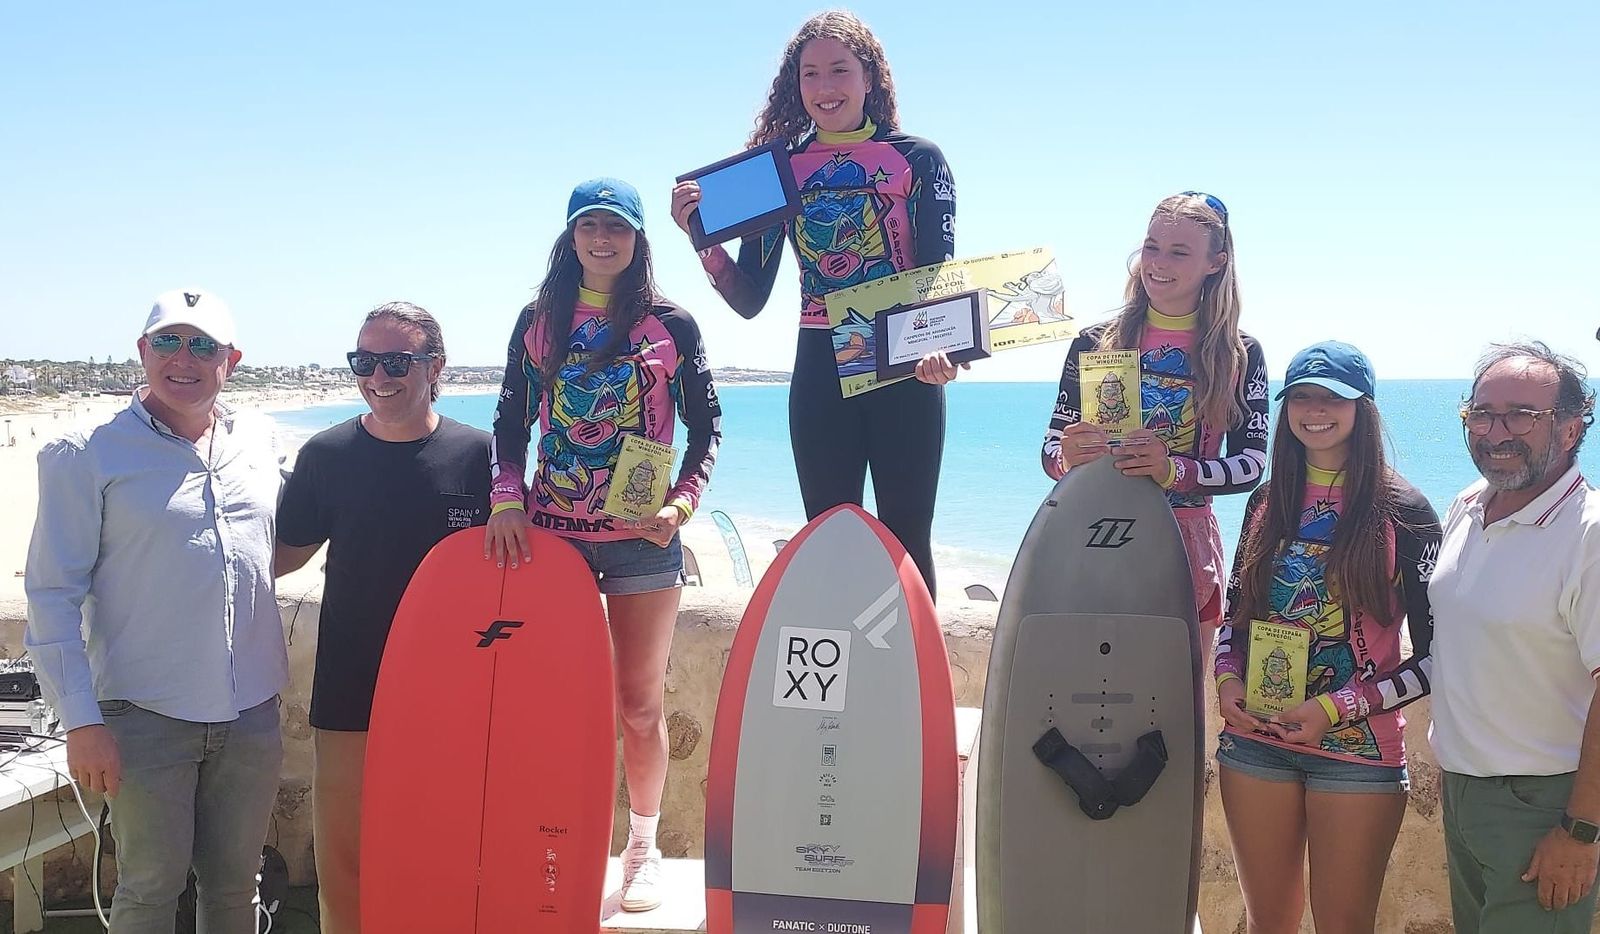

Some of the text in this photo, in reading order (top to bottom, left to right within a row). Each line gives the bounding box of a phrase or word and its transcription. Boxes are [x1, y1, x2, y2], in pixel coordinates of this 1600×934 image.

[915, 270, 965, 289] SPAIN
[917, 280, 966, 295] WING FOIL
[630, 438, 645, 447] COPA
[447, 507, 473, 517] SPAIN
[623, 507, 643, 516] FEMALE
[1281, 629, 1302, 637] ESPAÑA
[787, 636, 841, 668] RO
[783, 670, 838, 702] XY
[1263, 703, 1284, 712] FEMALE
[539, 825, 568, 834] Rocket
[804, 854, 846, 863] SURF
[772, 919, 815, 931] FANATIC
[827, 923, 871, 934] DUOTONE
